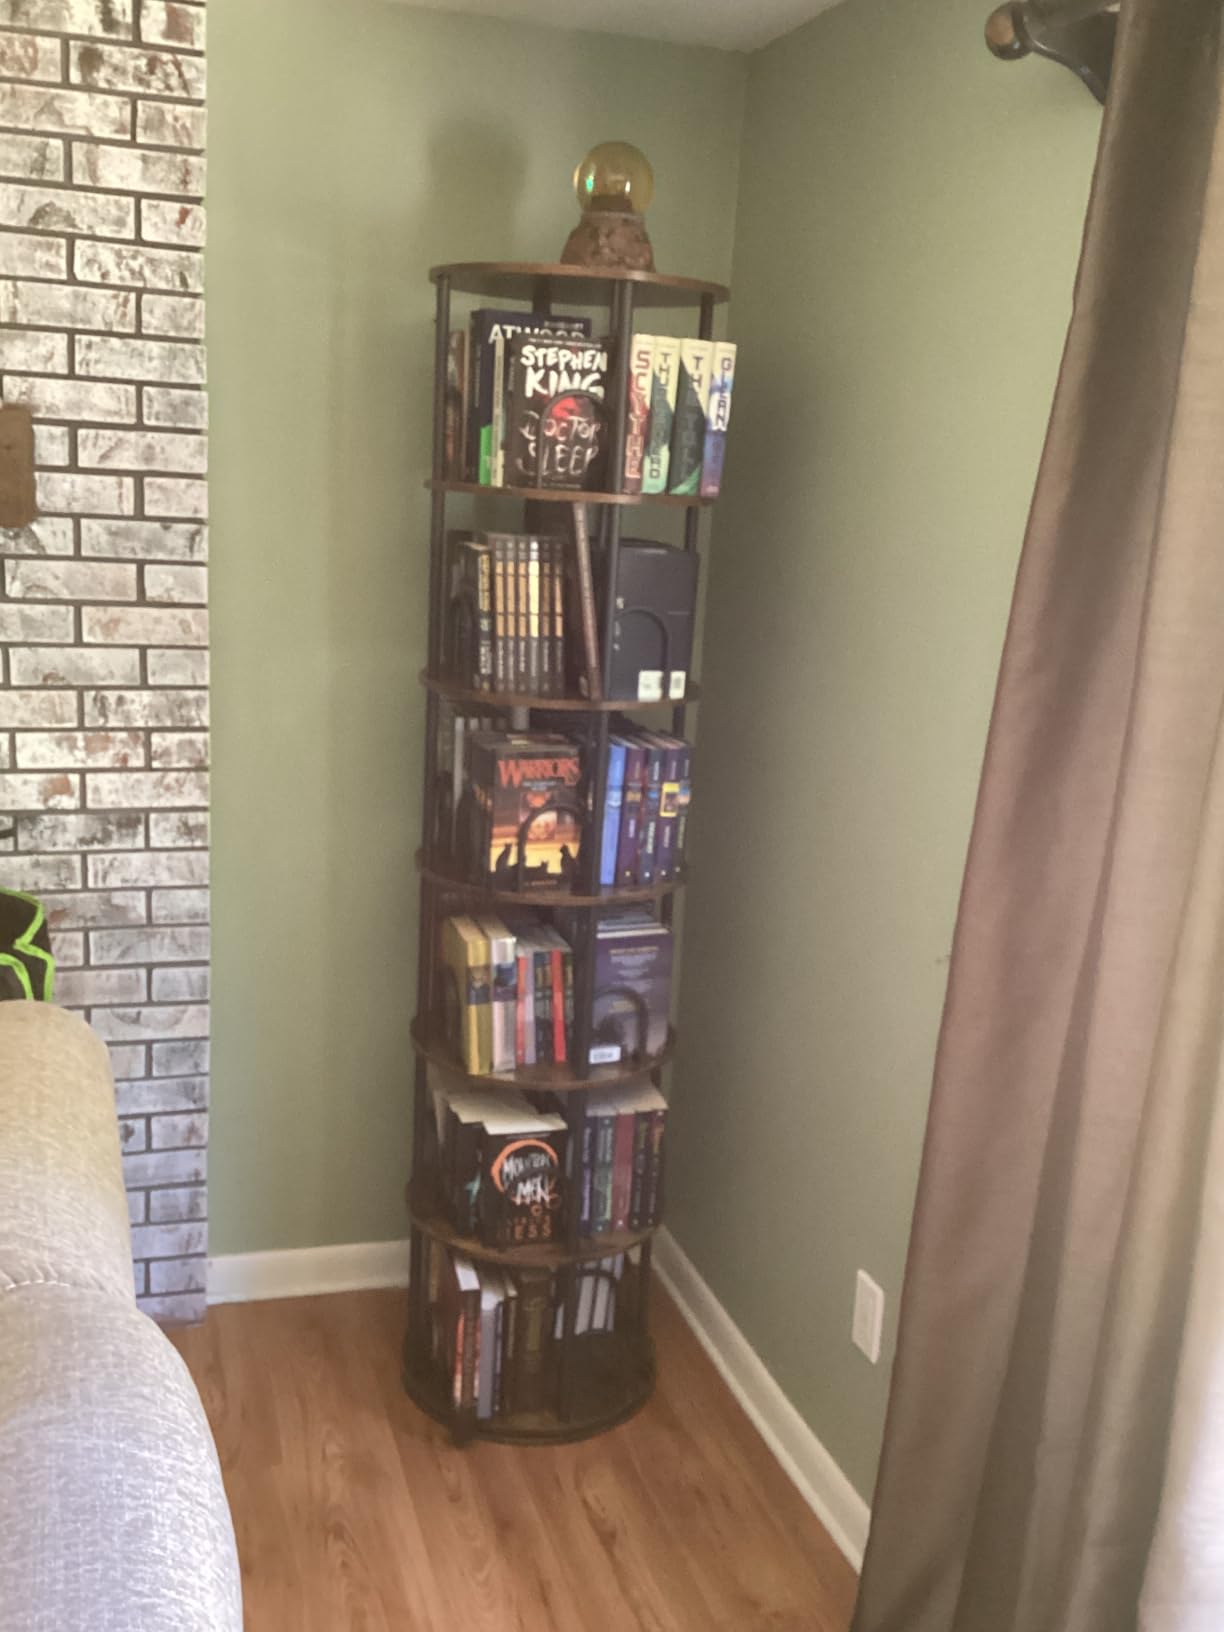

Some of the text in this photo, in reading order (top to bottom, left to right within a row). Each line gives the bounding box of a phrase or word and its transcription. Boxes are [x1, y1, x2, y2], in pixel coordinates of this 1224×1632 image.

[520, 344, 608, 371] STEPHEN
[525, 366, 604, 400] KING
[519, 410, 601, 442] DOCTOR
[624, 350, 650, 479] SCYTHE
[516, 442, 600, 476] SLEEP
